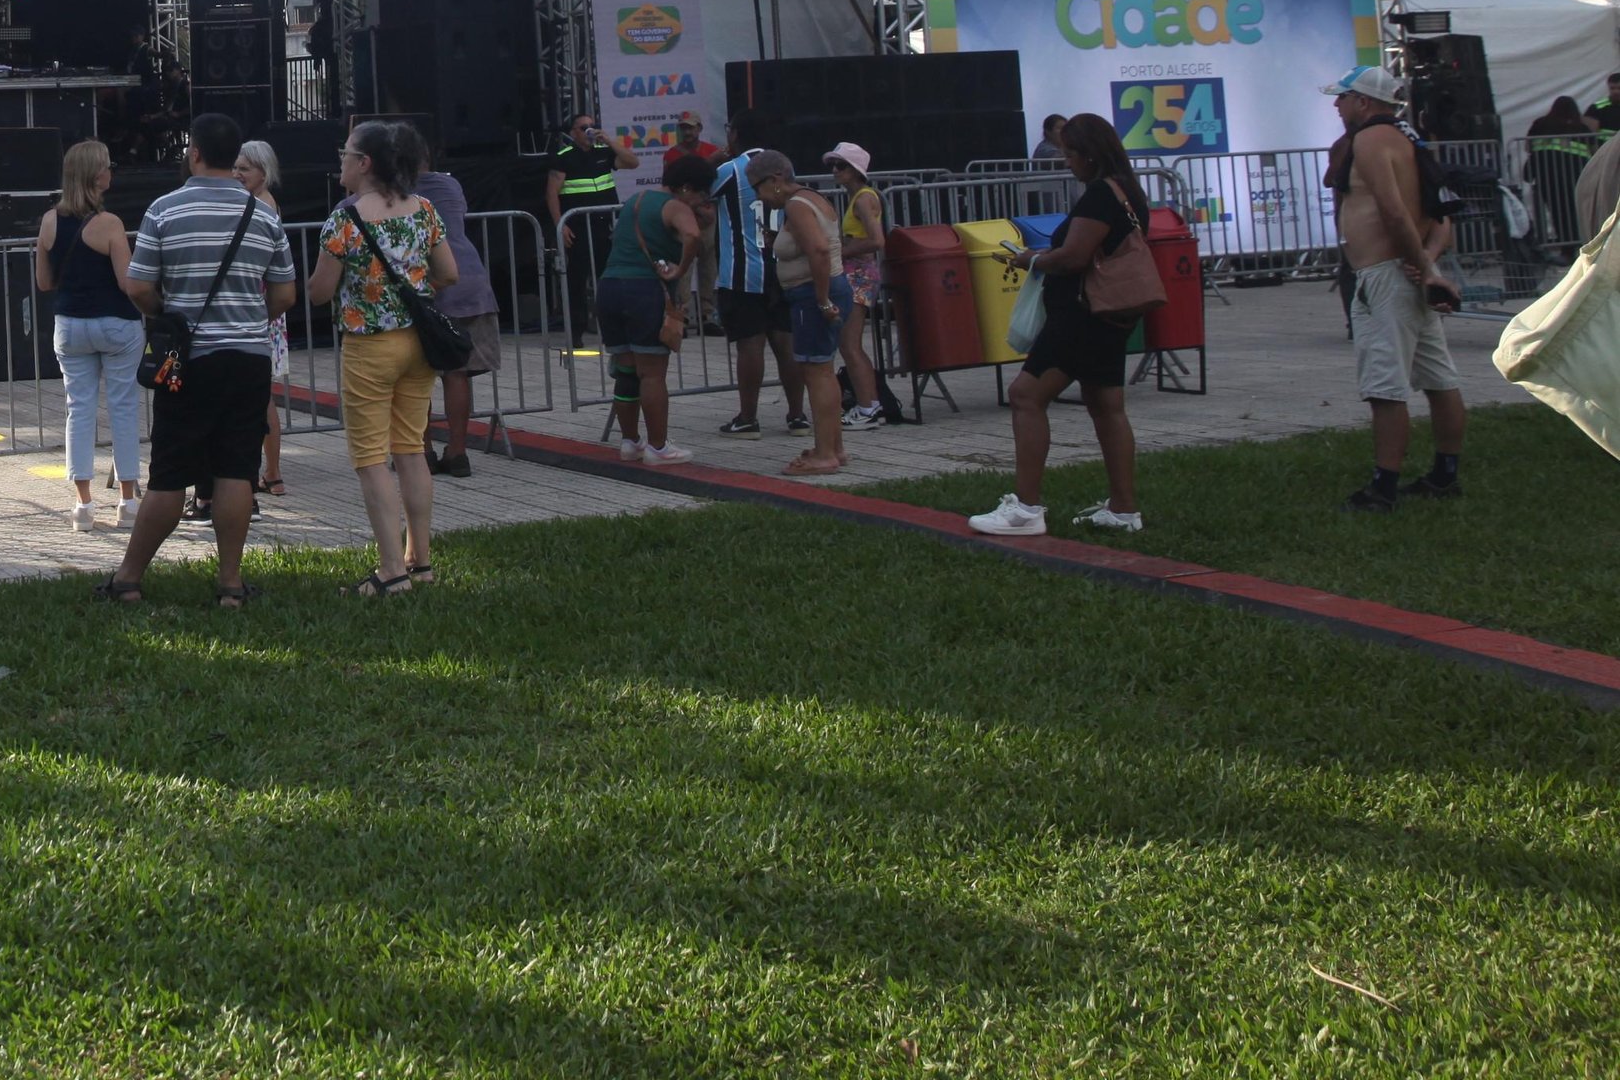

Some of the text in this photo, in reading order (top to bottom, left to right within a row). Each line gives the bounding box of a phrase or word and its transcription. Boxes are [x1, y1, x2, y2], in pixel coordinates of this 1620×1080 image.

[1120, 63, 1213, 78] PORTO ALEGRE
[612, 73, 696, 99] CAIXA
[632, 113, 667, 122] GOVERNO
[1119, 83, 1223, 150] 254
[1185, 120, 1217, 133] anos
